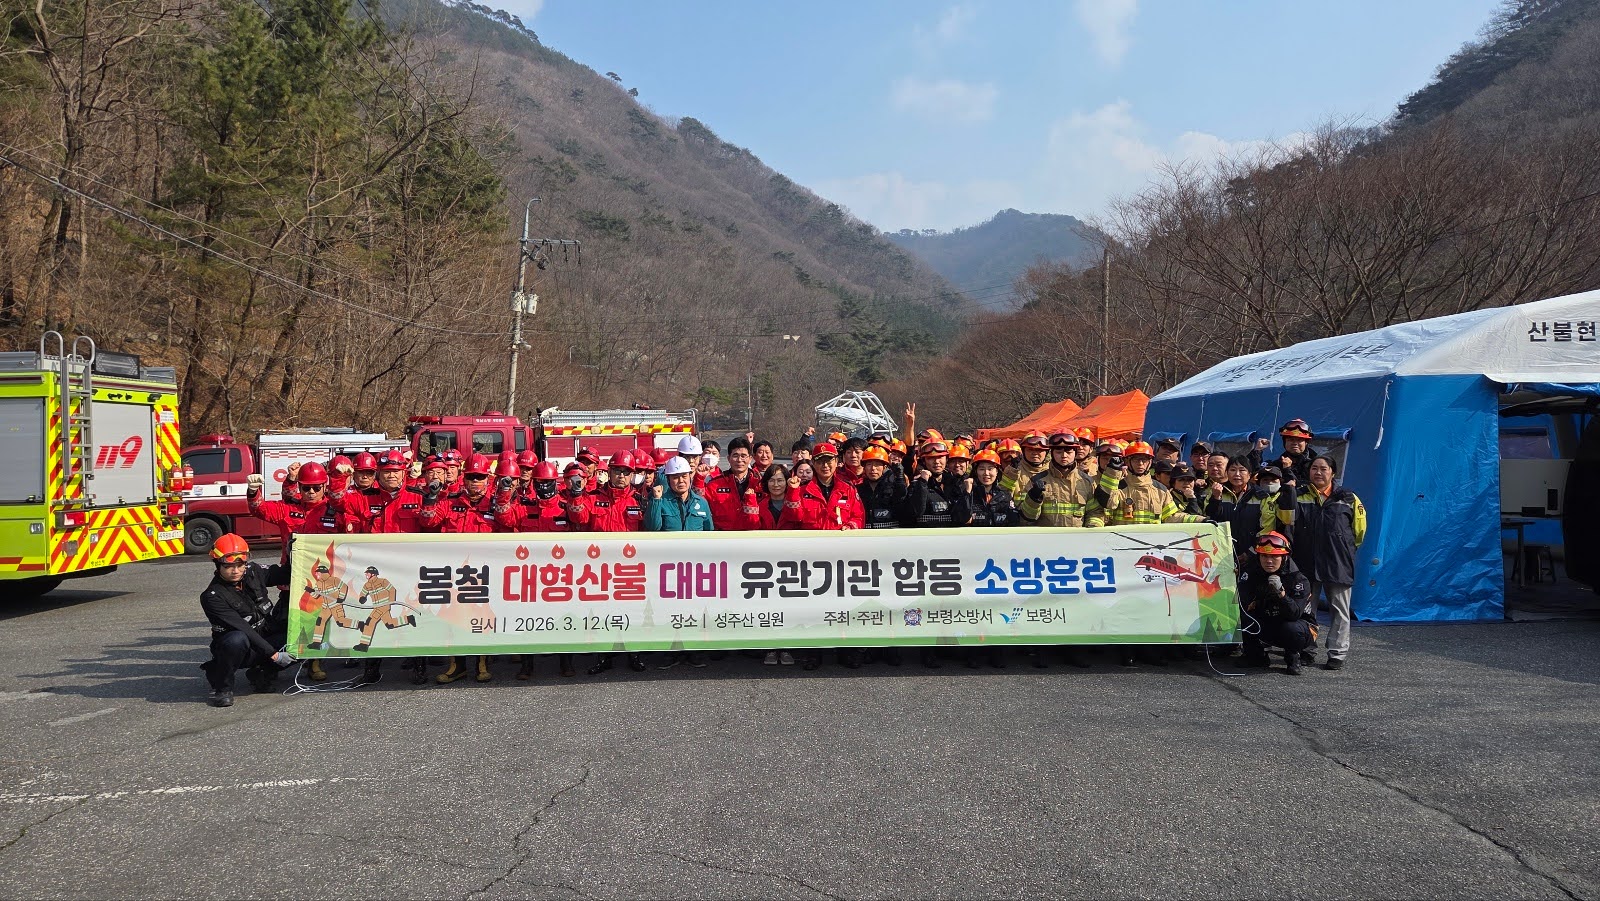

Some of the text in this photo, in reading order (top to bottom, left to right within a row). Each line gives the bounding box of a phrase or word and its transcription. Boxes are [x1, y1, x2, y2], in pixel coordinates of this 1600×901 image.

[1528, 321, 1597, 342] 산불현
[94, 435, 143, 469] 119
[876, 509, 889, 517] 119
[996, 514, 1007, 522] 119
[418, 556, 1117, 604] 봄철 대형산불 대비 유관기관 합동 소방훈련
[470, 613, 630, 633] 일시 2026. 3. 12.(목)
[670, 611, 784, 629] 장소 성주산 일원
[823, 610, 885, 627] 주최·주관
[926, 608, 993, 625] 보령소방서
[1026, 607, 1066, 624] 보령시
